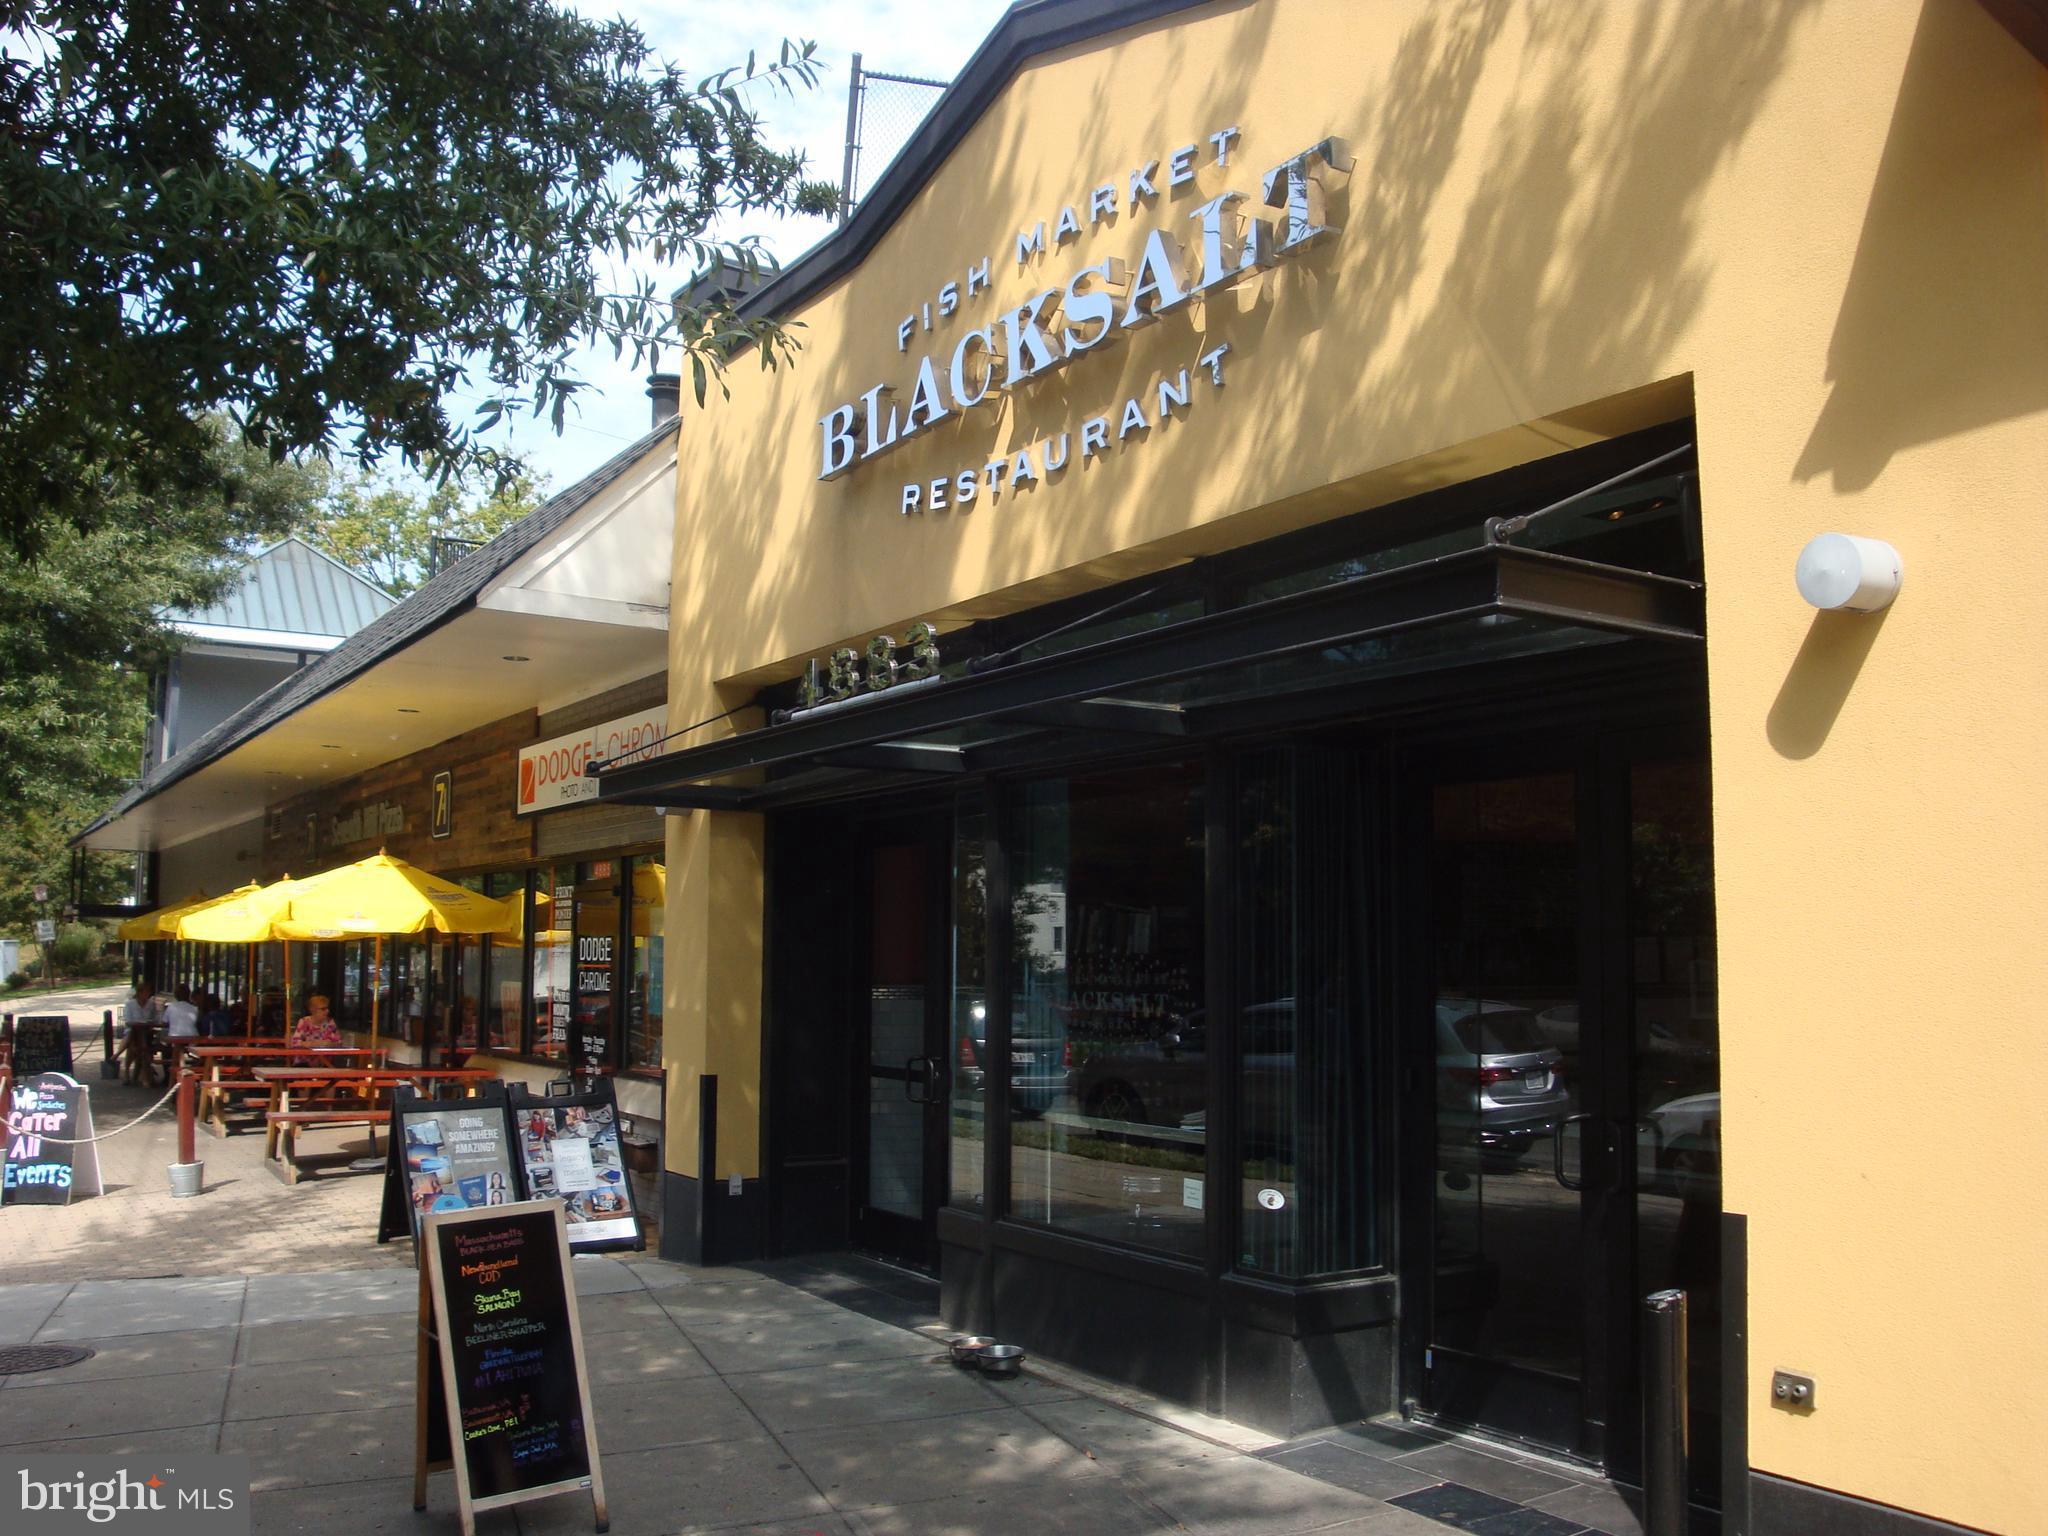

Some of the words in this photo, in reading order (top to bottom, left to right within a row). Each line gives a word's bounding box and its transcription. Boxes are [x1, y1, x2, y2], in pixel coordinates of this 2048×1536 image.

[898, 256, 993, 352] FISH
[1016, 125, 1239, 265] MARKET
[817, 135, 1358, 481] BLACKSALT
[901, 342, 1232, 515] RESTAURANT
[579, 936, 612, 962] DODGE
[579, 971, 612, 993] CHROME
[459, 1117, 483, 1128] GOING
[448, 1128, 499, 1142] SOMEWHERE
[455, 1141, 496, 1154] AMAZING?
[478, 1270, 500, 1285] COD
[476, 1298, 515, 1315] SALMON
[473, 1322, 496, 1335] North
[496, 1317, 528, 1330] Carolina
